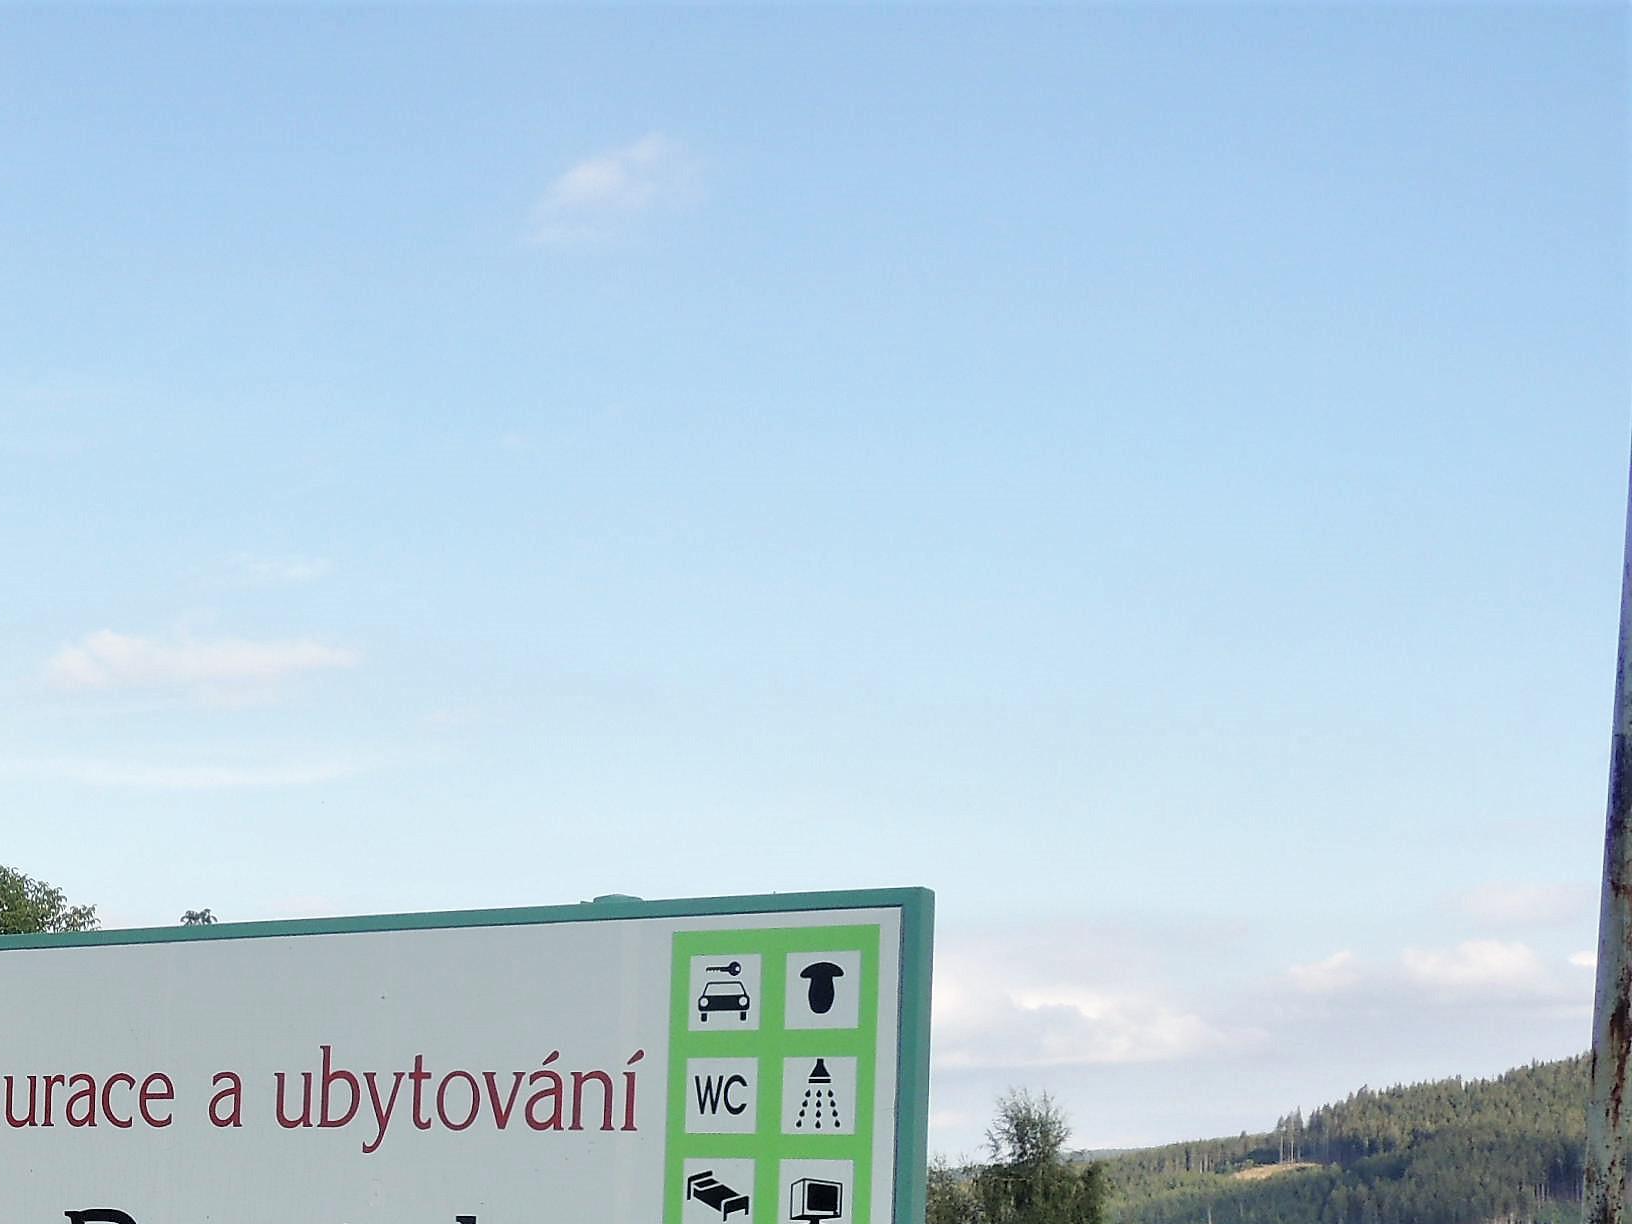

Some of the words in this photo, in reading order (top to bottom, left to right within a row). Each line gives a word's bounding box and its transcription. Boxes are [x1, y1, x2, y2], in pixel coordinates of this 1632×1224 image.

[209, 1071, 243, 1129] a
[273, 1045, 646, 1154] ubytování
[694, 1074, 748, 1116] WC
